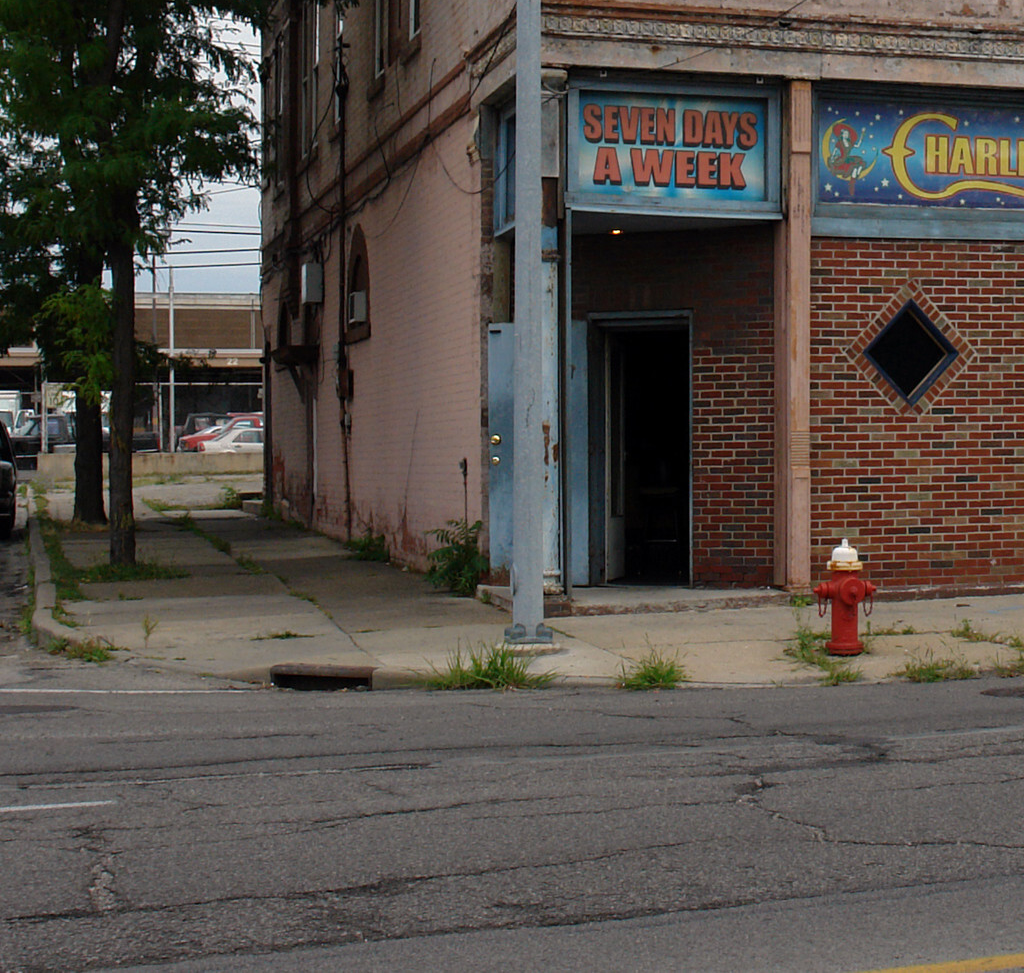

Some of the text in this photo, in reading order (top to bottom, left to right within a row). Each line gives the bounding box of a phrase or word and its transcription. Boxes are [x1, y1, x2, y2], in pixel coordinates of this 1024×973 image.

[583, 103, 758, 150] SEVEN DAYS
[593, 147, 747, 190] A WEEK
